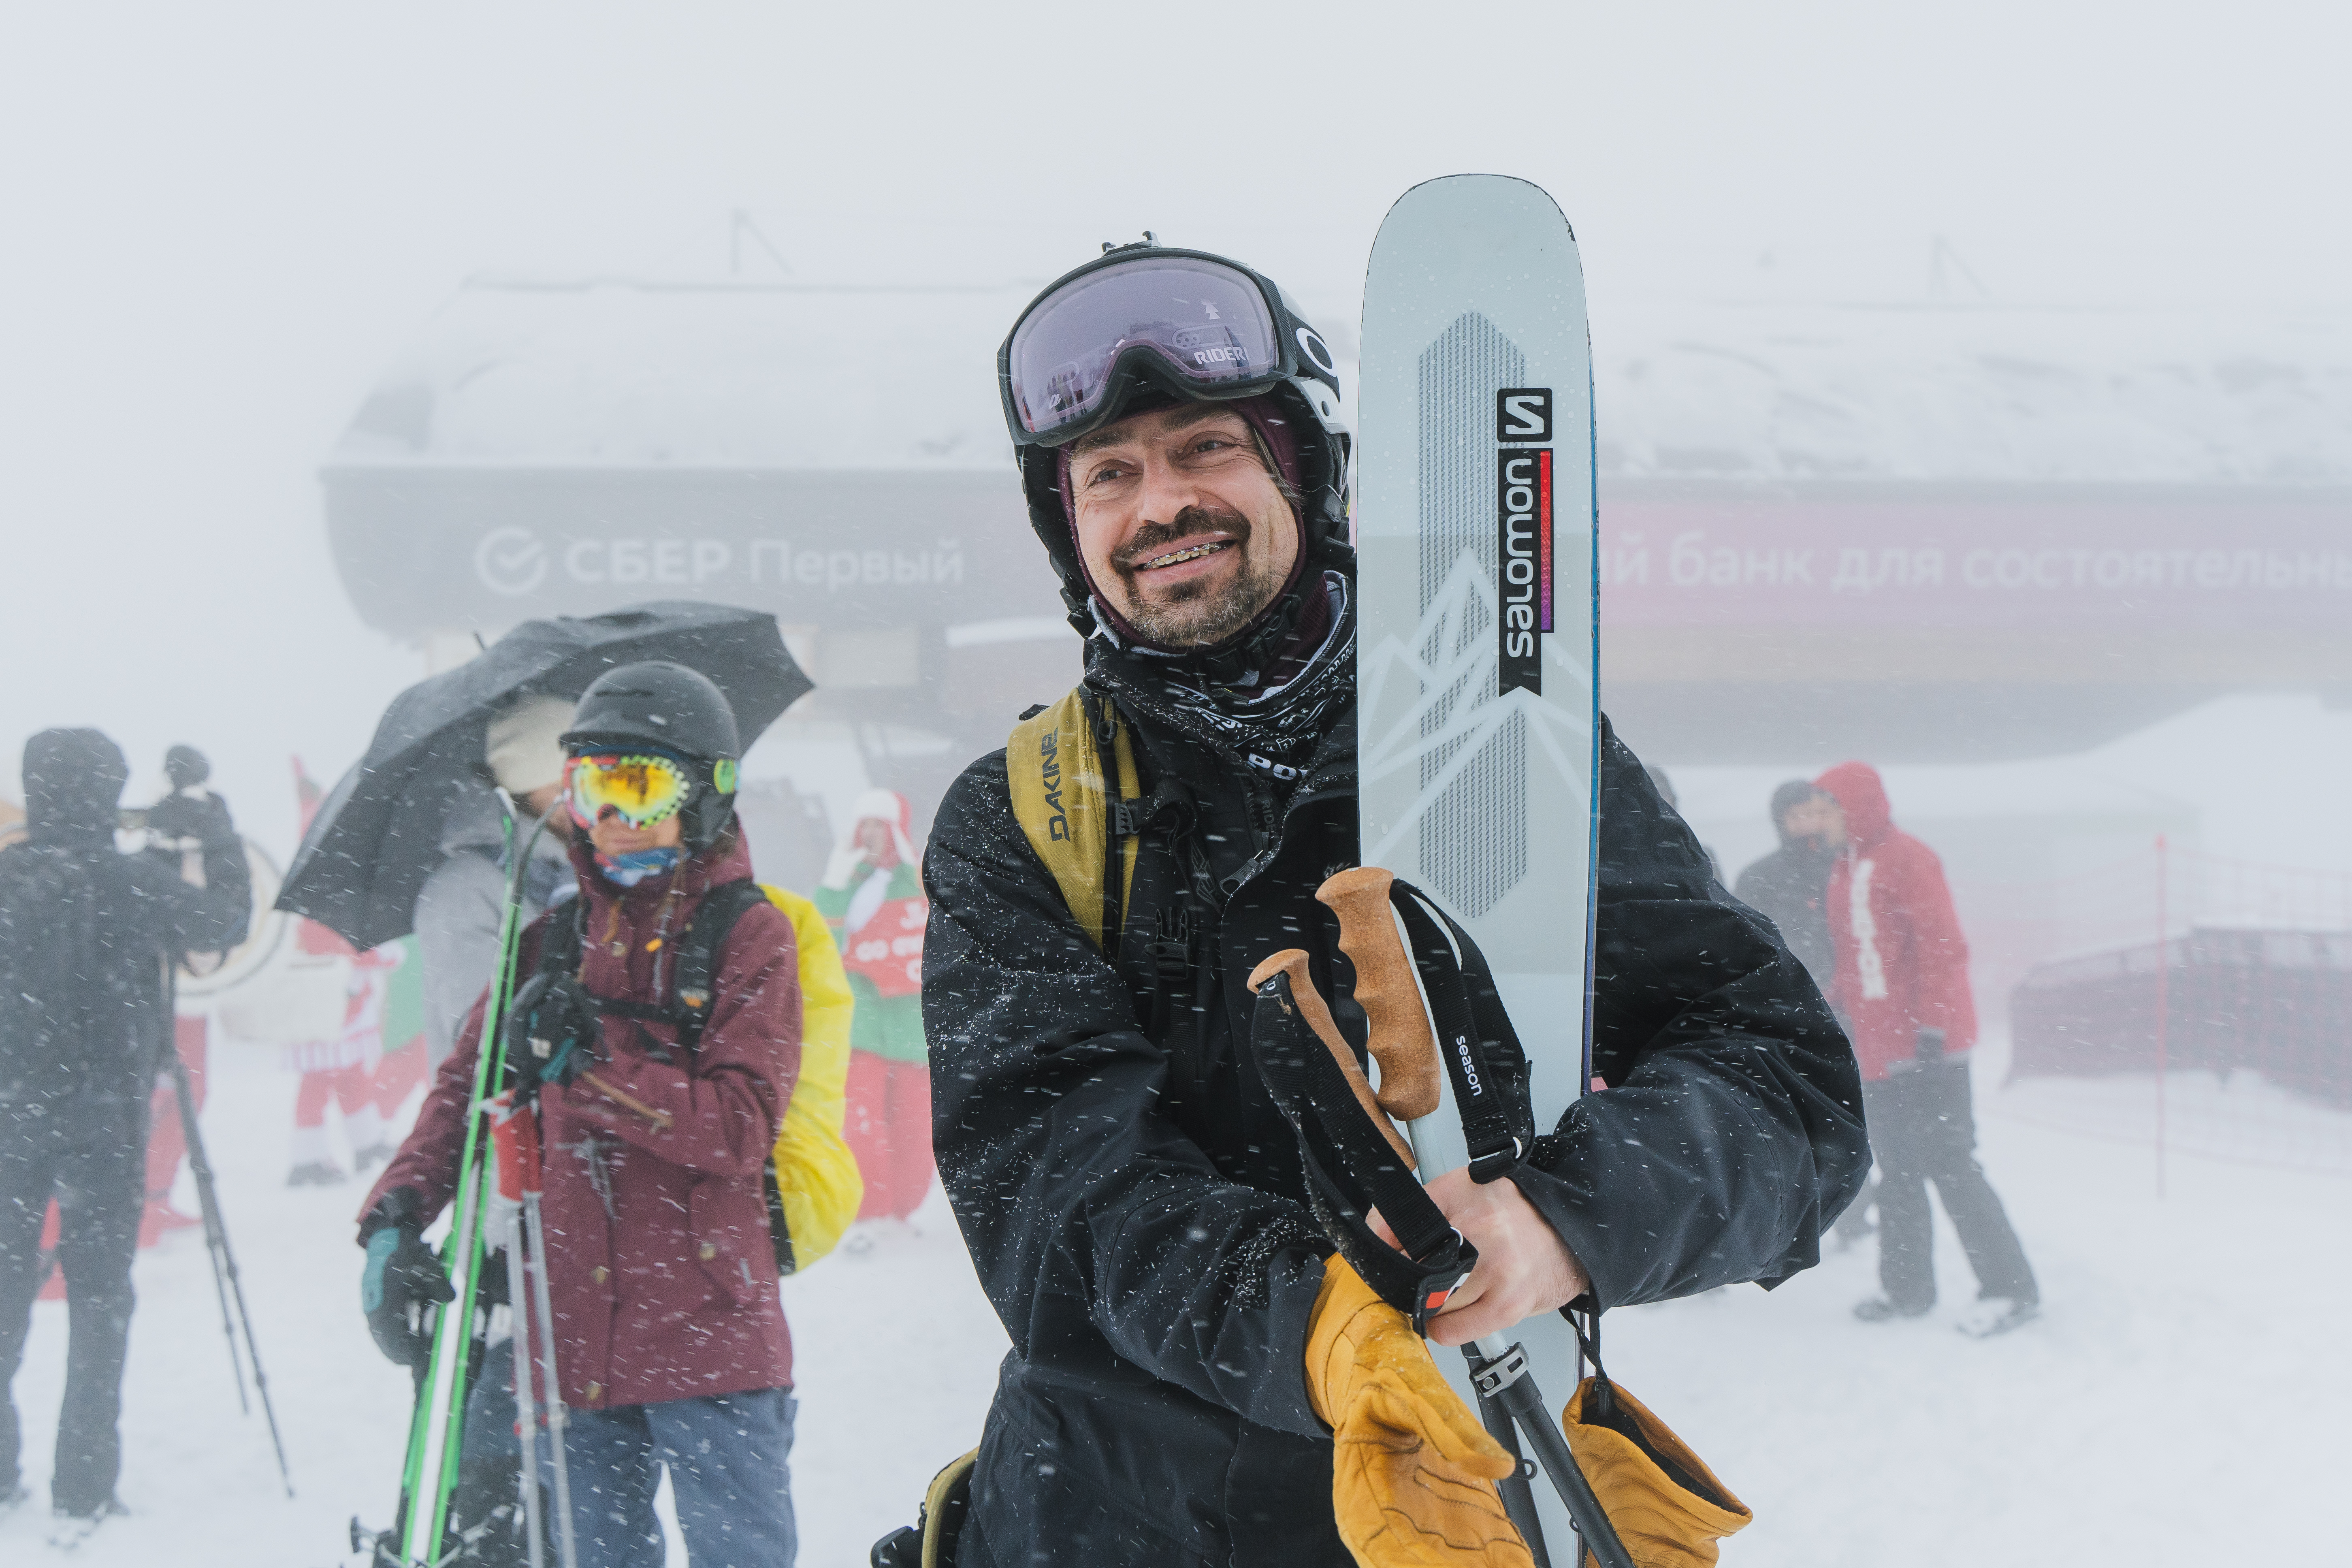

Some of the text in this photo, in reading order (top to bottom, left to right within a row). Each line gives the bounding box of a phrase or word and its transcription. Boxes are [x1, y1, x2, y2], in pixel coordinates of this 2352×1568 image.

[564, 536, 965, 593] СБЕР Первый
[1505, 458, 1533, 657] salomon
[1668, 527, 1817, 588] банк
[1830, 547, 1947, 595] для
[1041, 726, 1070, 843] DAKINE
[1456, 1035, 1482, 1096] season
